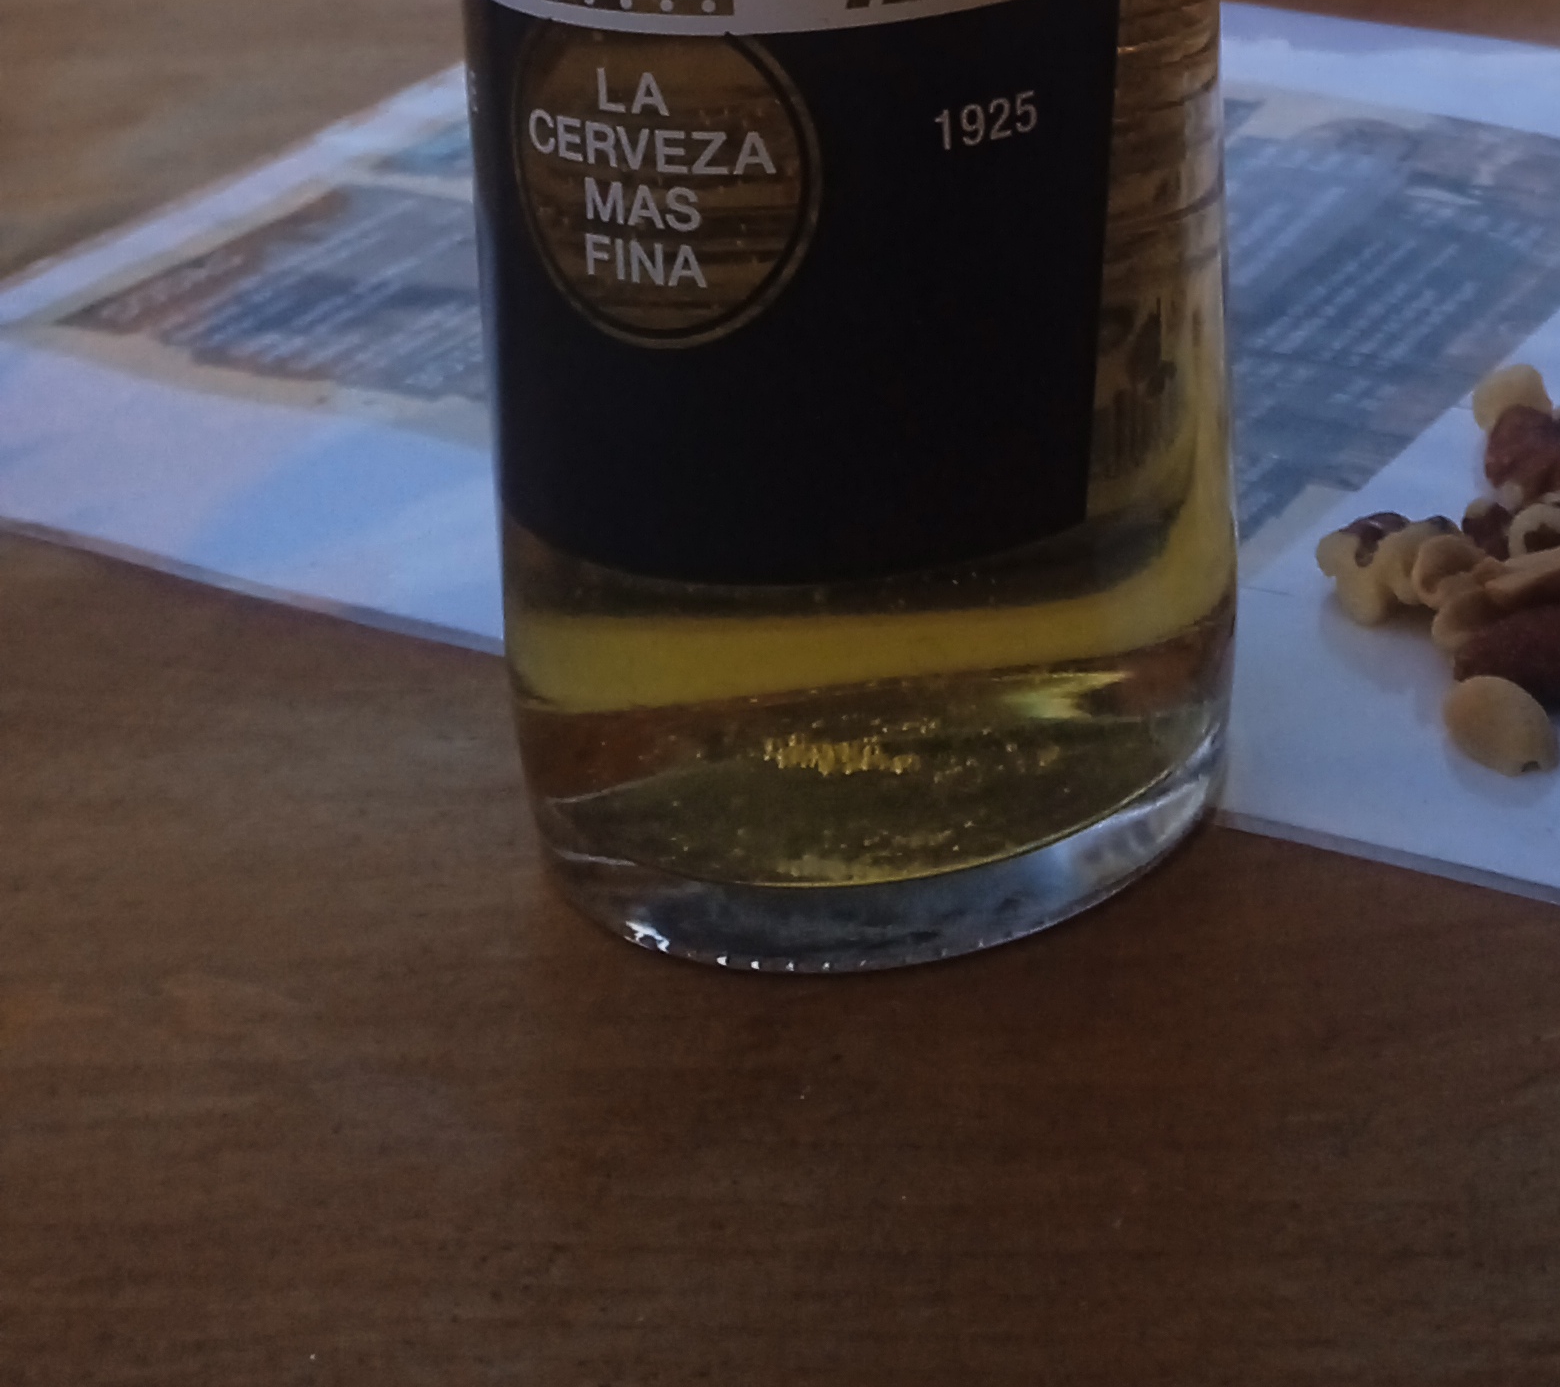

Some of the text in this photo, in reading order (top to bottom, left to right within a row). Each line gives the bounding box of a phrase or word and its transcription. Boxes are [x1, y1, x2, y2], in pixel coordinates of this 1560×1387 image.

[597, 67, 670, 117] LA
[529, 108, 777, 175] CERVEZA
[935, 91, 1038, 150] 1925
[584, 178, 701, 232] MAS
[584, 233, 707, 288] FINA
